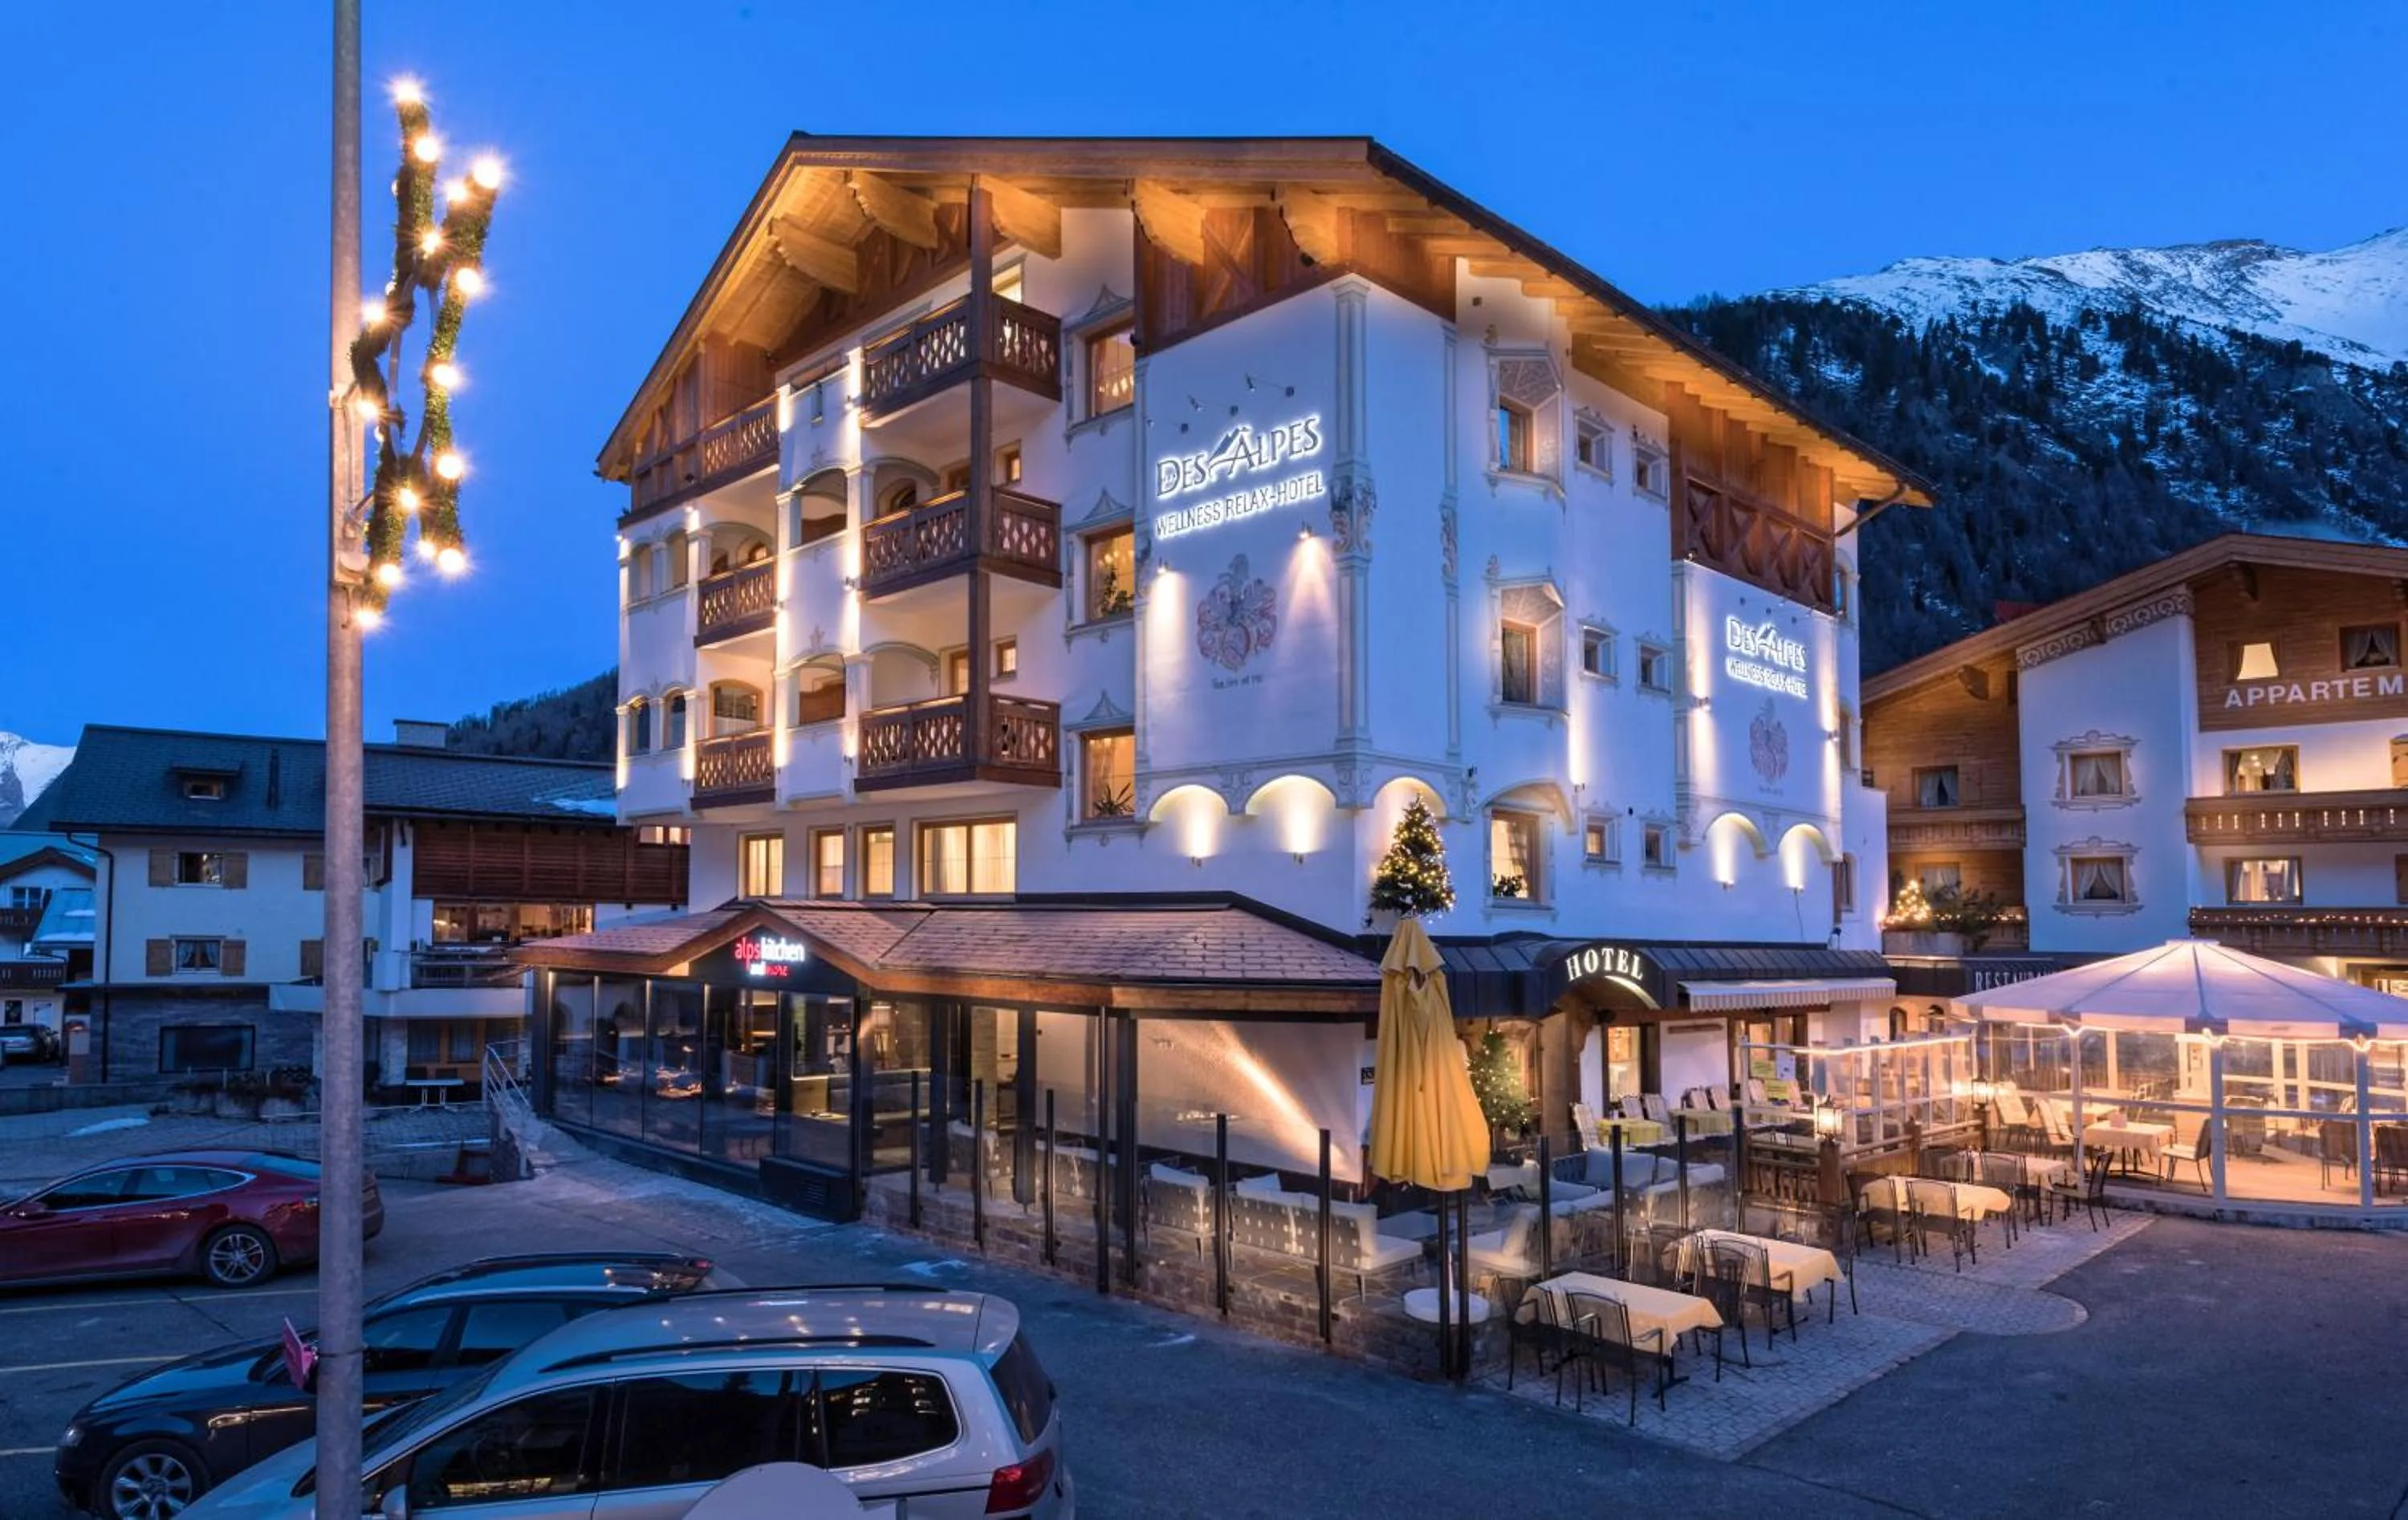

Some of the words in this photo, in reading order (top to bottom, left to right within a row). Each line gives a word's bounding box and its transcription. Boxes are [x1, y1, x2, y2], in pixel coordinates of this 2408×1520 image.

[1156, 451, 1207, 498] DES
[1155, 500, 1222, 537] WELLNESS
[1225, 473, 1324, 520] RELAX-HOTEL
[1729, 619, 1757, 654] DES
[1565, 947, 1644, 982] HOTEL
[1975, 970, 2052, 993] RESTA
